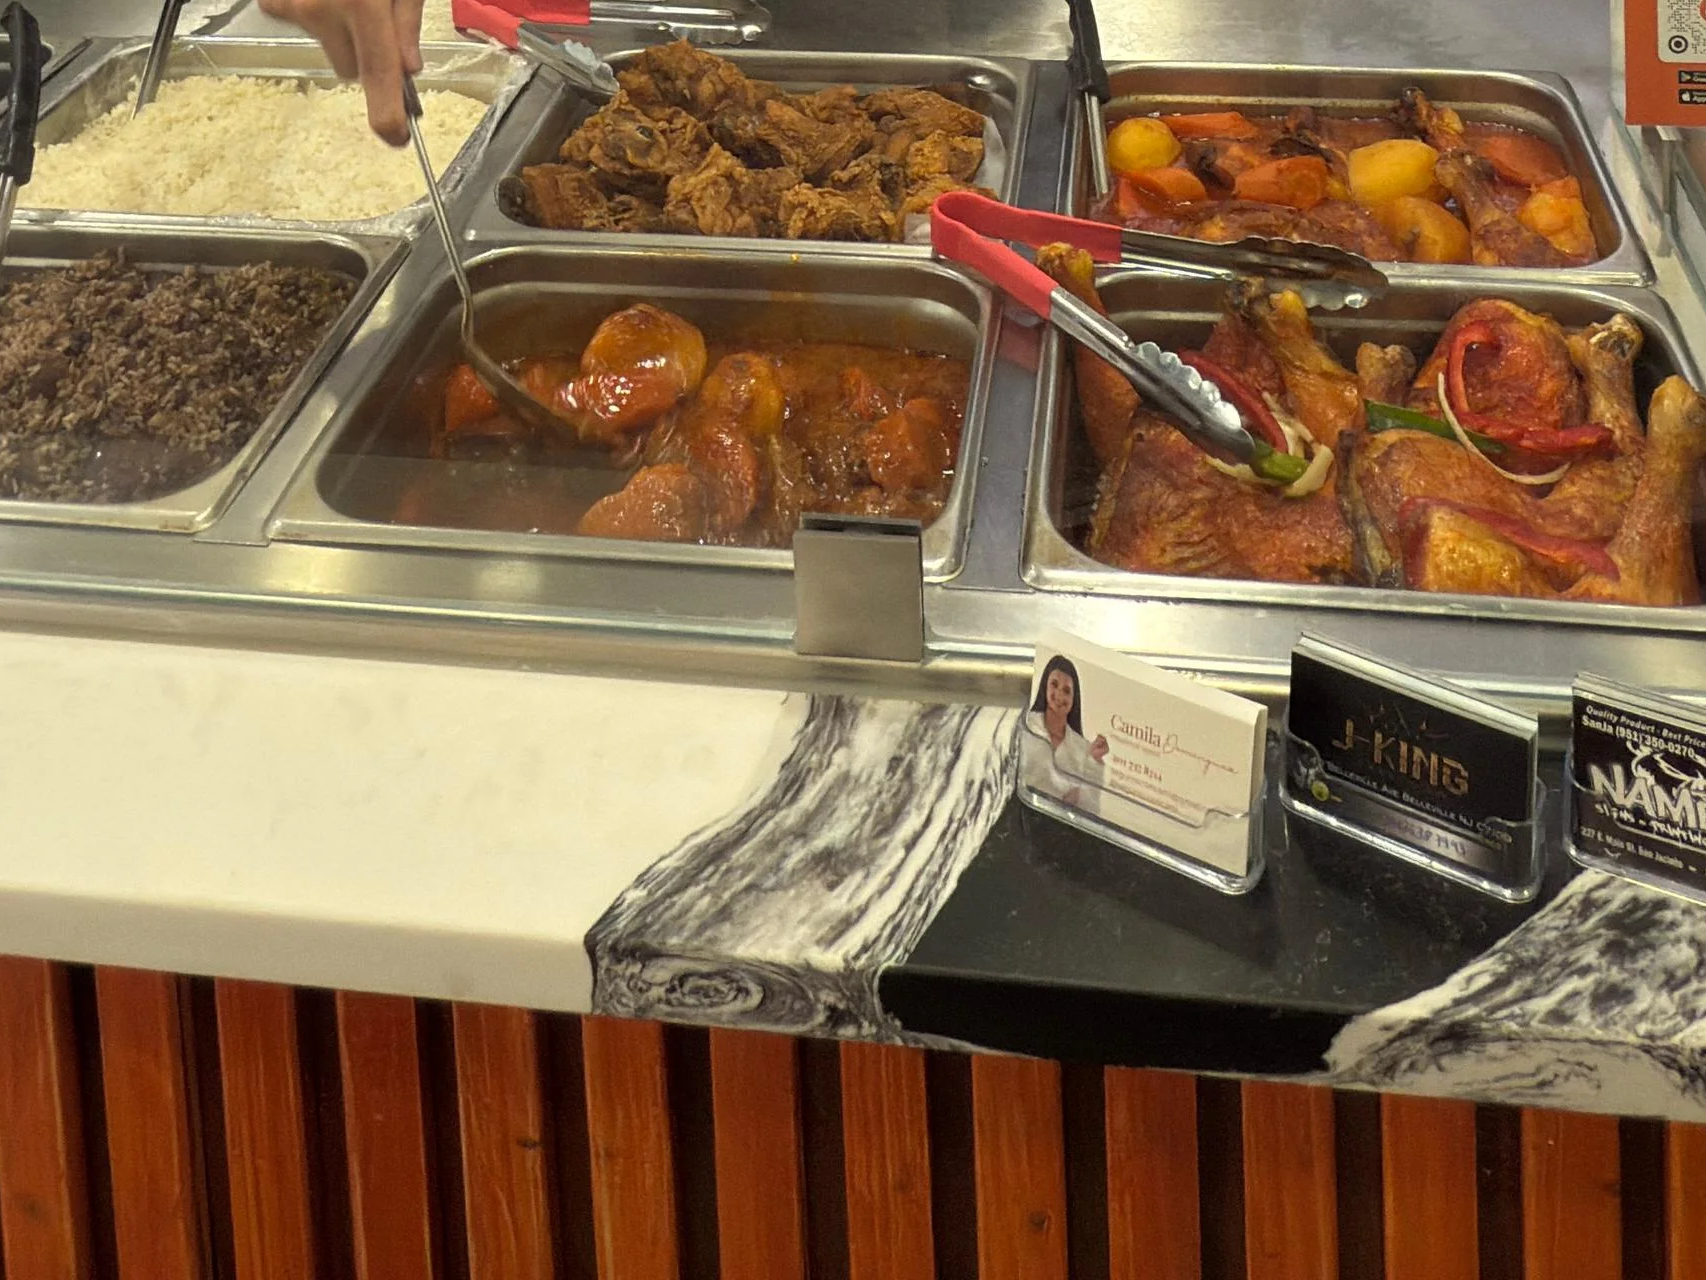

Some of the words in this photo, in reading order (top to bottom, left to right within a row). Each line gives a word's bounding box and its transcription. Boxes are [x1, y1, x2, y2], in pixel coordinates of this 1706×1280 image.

[1111, 714, 1161, 748] Camila
[1586, 705, 1618, 723] Quality
[1619, 714, 1655, 733] Product
[1615, 725, 1643, 745] (951)
[1644, 732, 1695, 759] 350-0270
